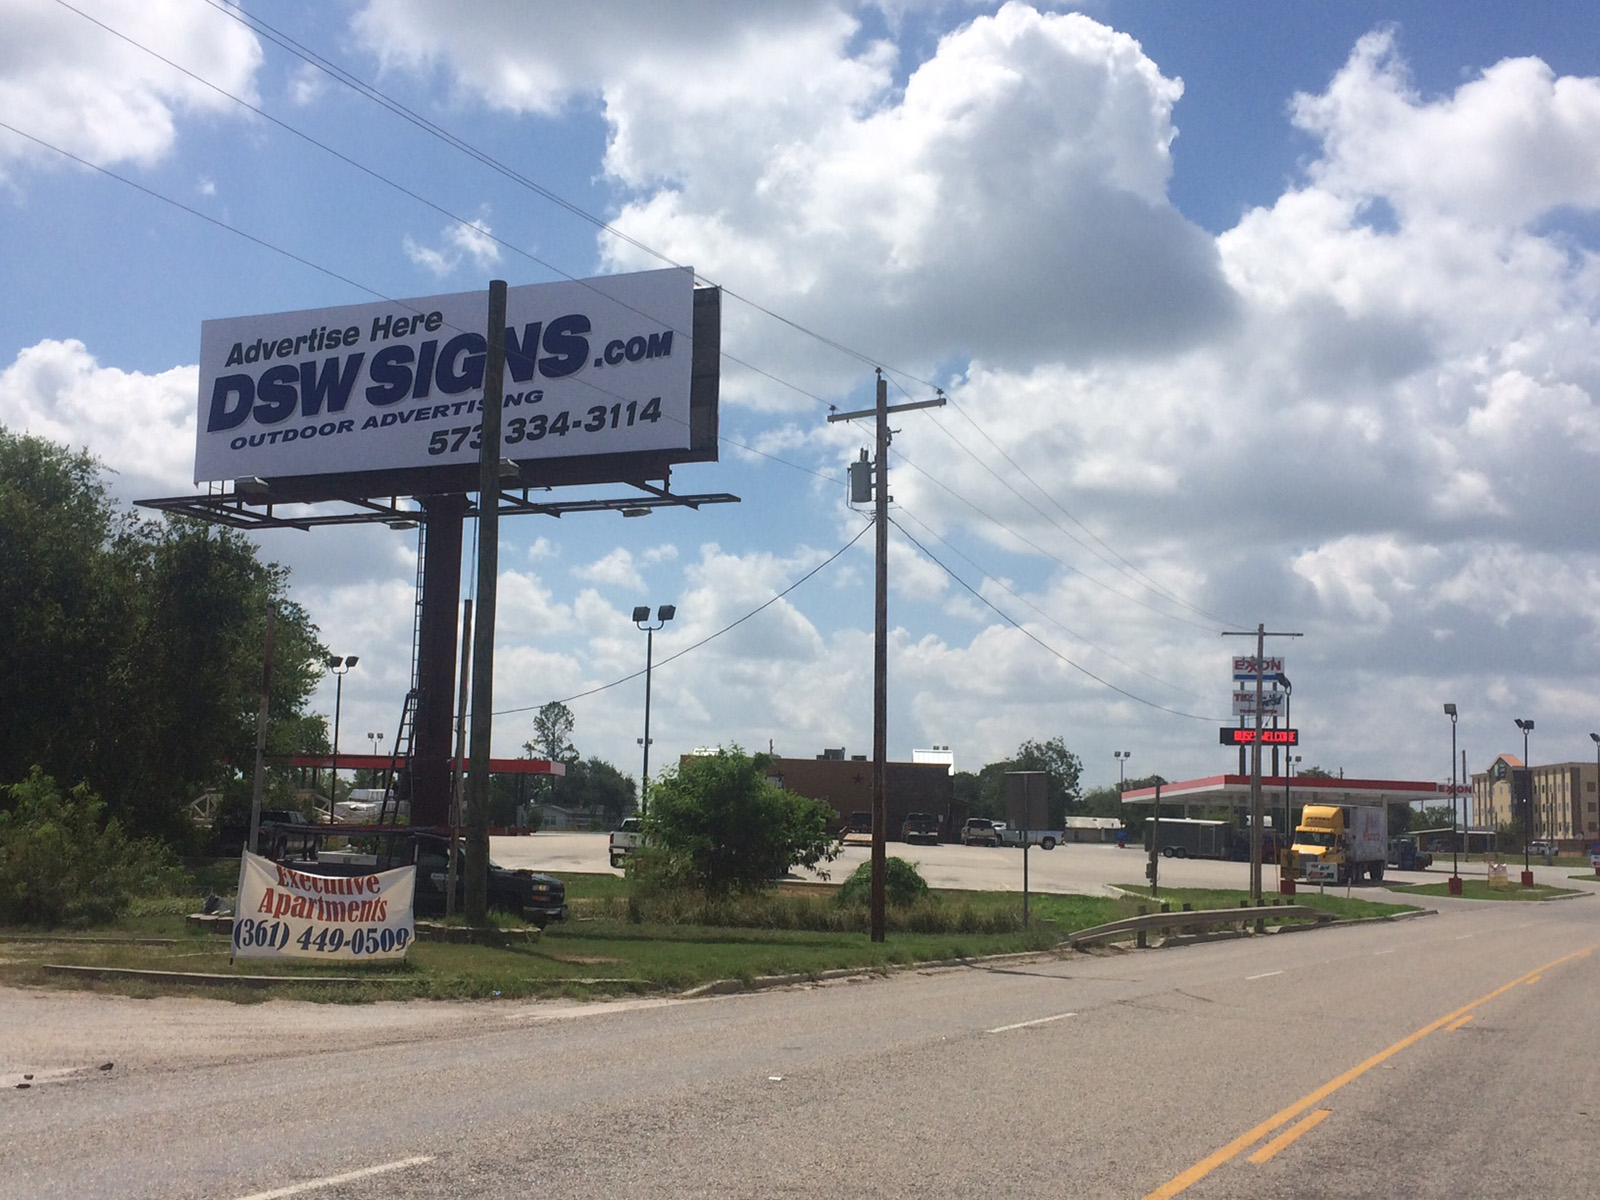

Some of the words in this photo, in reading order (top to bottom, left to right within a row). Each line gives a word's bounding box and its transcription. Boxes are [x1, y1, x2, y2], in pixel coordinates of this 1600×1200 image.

[225, 325, 360, 368] Advertise
[370, 311, 443, 342] Here
[230, 419, 355, 450] OUTDOOR
[361, 390, 544, 430] ADVERTING
[1438, 784, 1472, 795] EXXON
[276, 865, 381, 895] Executive
[257, 888, 388, 923] Apartments
[234, 918, 290, 951] (361)
[296, 926, 409, 955] 449-0509
